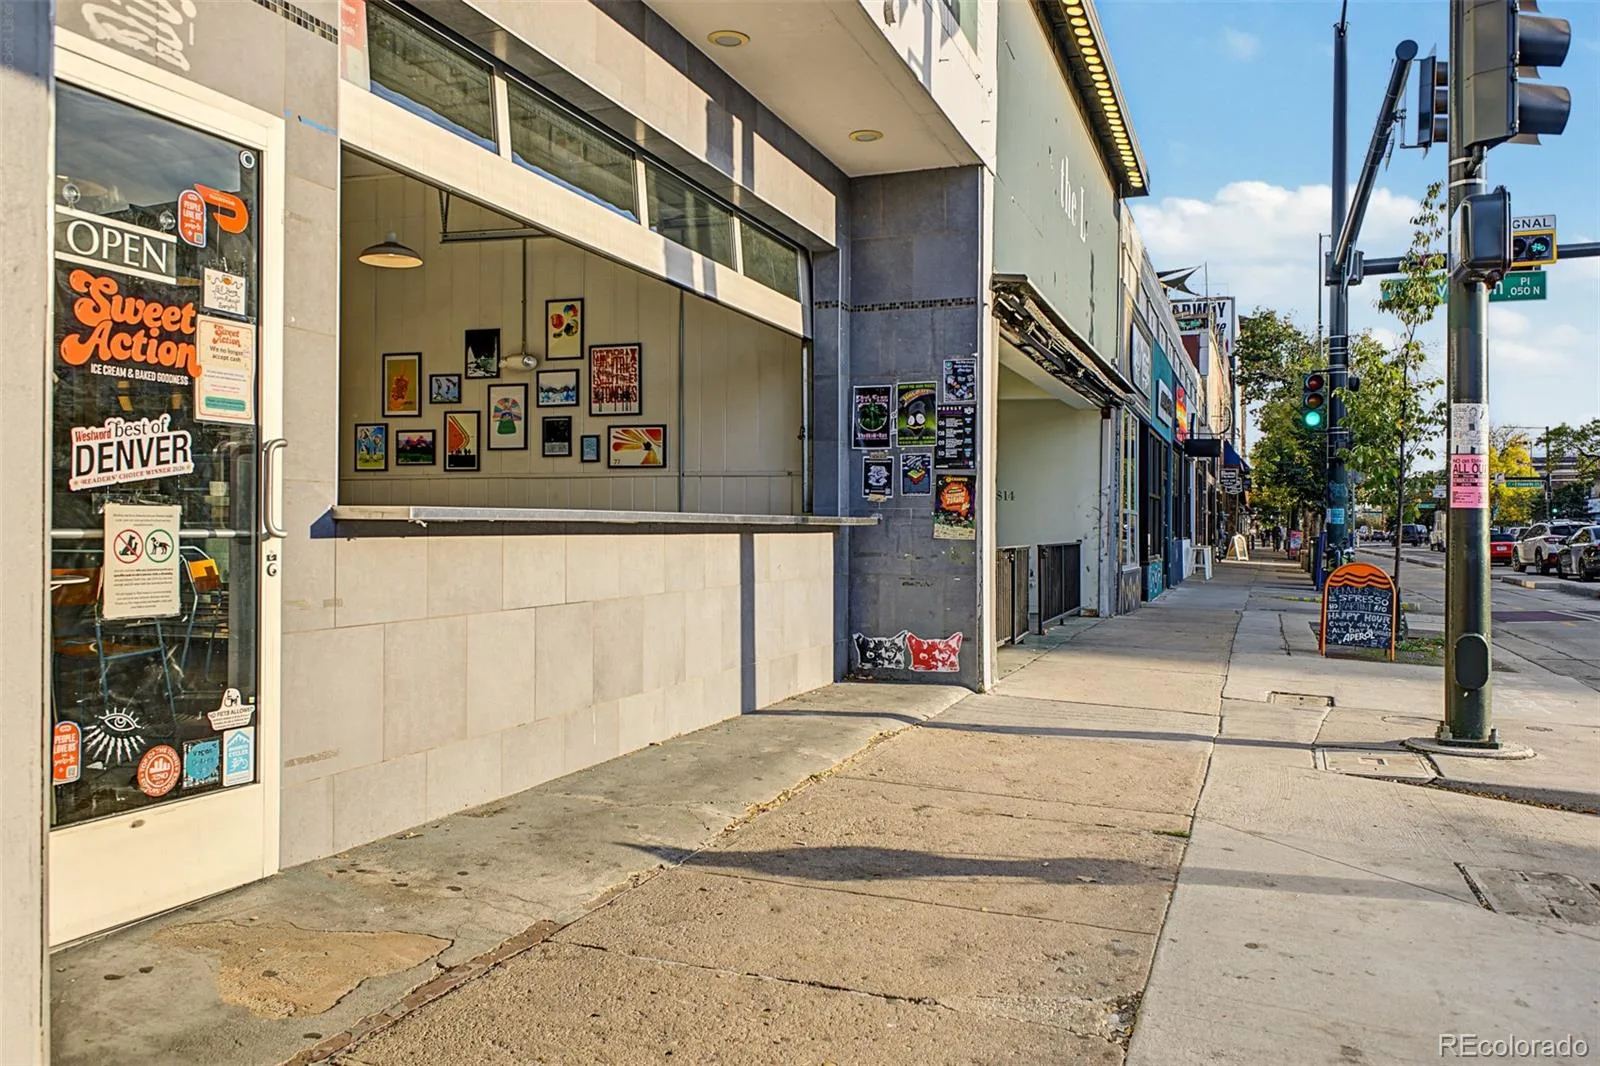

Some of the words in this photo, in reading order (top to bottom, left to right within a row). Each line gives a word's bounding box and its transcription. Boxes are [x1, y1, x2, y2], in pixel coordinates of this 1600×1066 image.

[1512, 217, 1551, 229] GNAL
[67, 220, 167, 273] OPEN
[1533, 286, 1540, 294] N
[69, 269, 196, 335] Sweet
[213, 324, 240, 337] Sweet
[60, 319, 202, 378] Action
[212, 337, 241, 347] Action
[91, 363, 102, 375] ICE
[103, 364, 127, 378] CREAM
[127, 368, 134, 379] &
[135, 369, 156, 381] BAKED
[157, 372, 189, 385] GOODNESS
[75, 428, 112, 442] Westword
[108, 420, 148, 438] best
[151, 417, 168, 433] of
[76, 434, 190, 477] DENVER
[119, 470, 144, 480] CHOICE
[145, 467, 171, 476] WINNER
[1453, 464, 1470, 474] ALL
[1328, 612, 1360, 621] HAPPY
[1364, 614, 1391, 624] HOUR
[1343, 632, 1375, 642] APEROL
